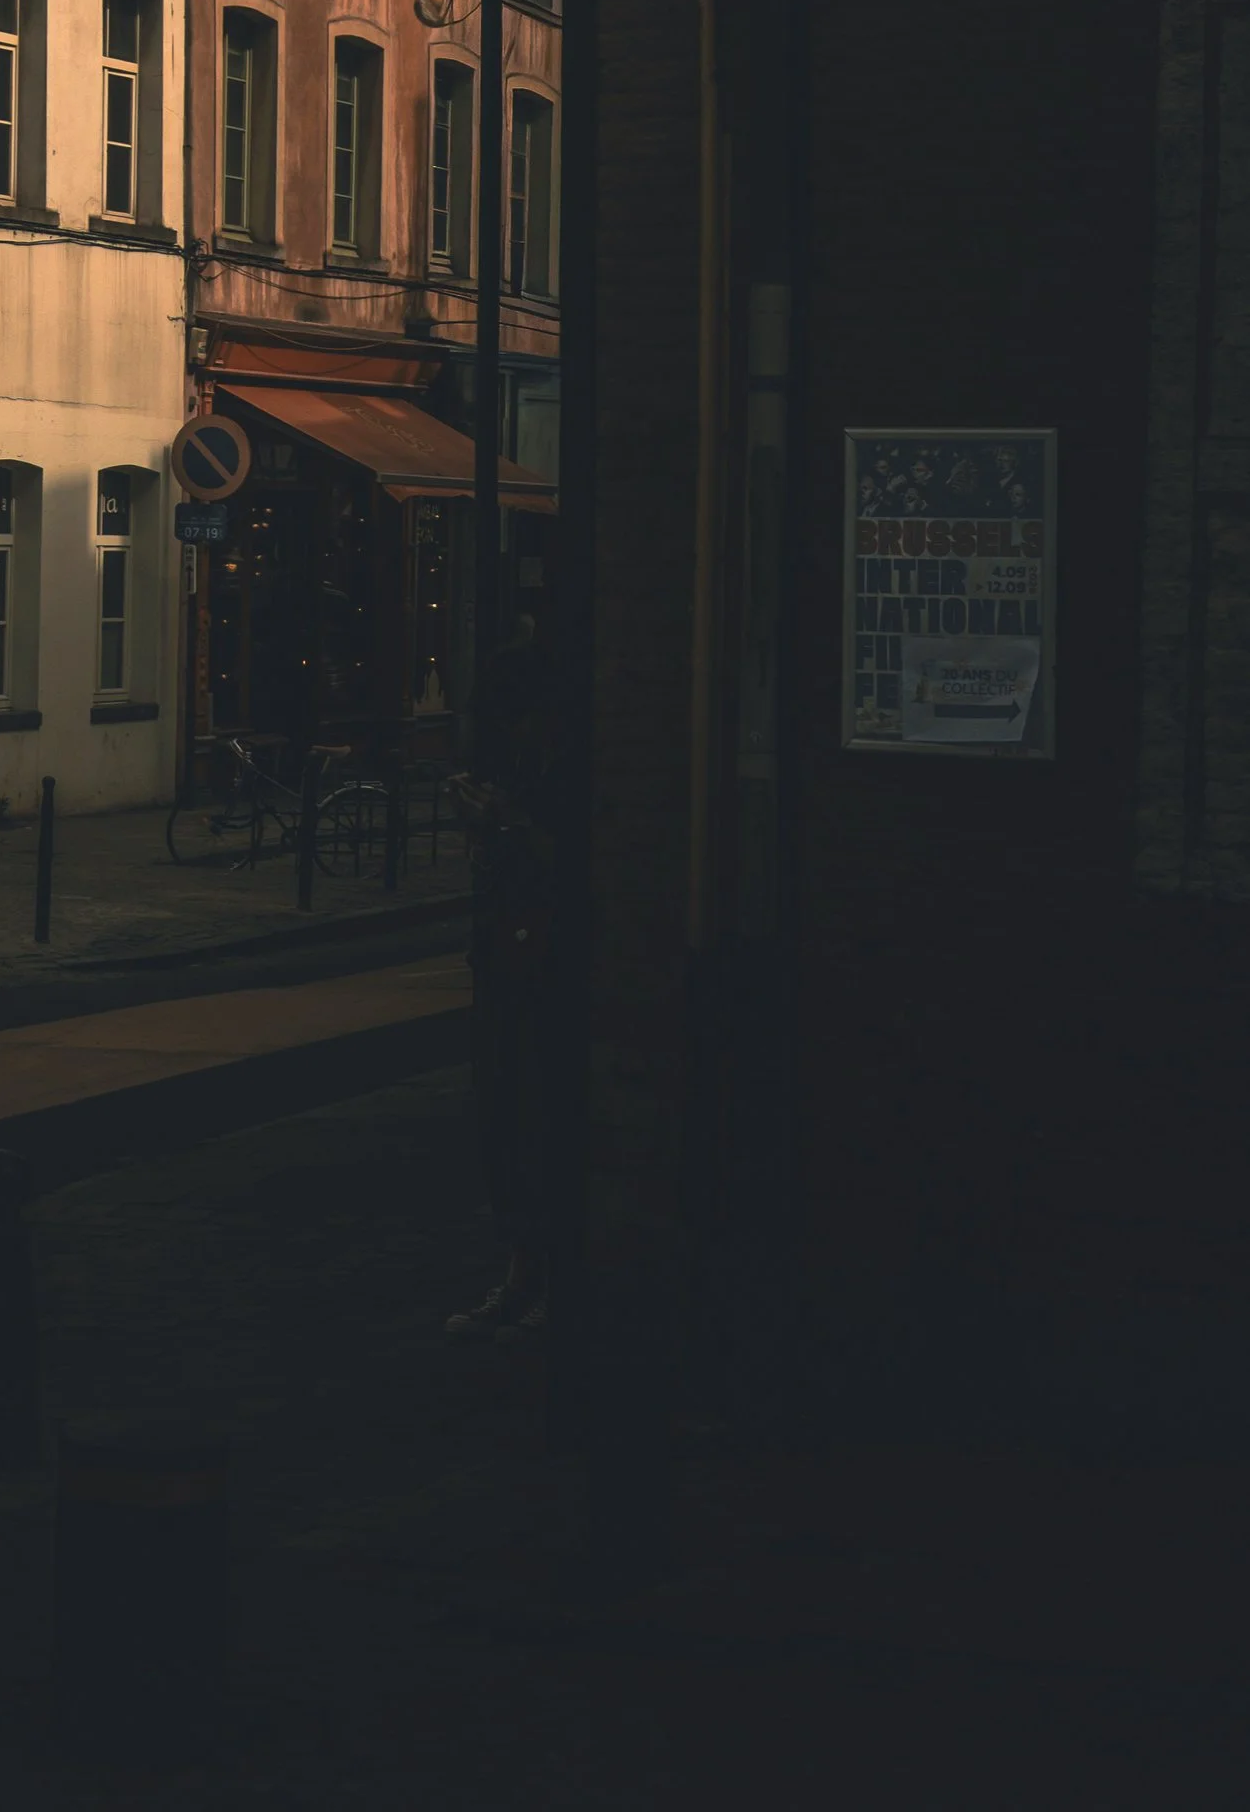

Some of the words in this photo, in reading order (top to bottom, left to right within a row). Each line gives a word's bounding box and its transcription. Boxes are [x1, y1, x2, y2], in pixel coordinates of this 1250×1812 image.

[856, 518, 1044, 558] BRUSSELS
[856, 558, 968, 596] INTER
[856, 596, 1043, 636] NATIONAL
[941, 682, 1017, 696] COLLECTIF
[962, 668, 992, 681] ANS
[995, 669, 1019, 682] DU
